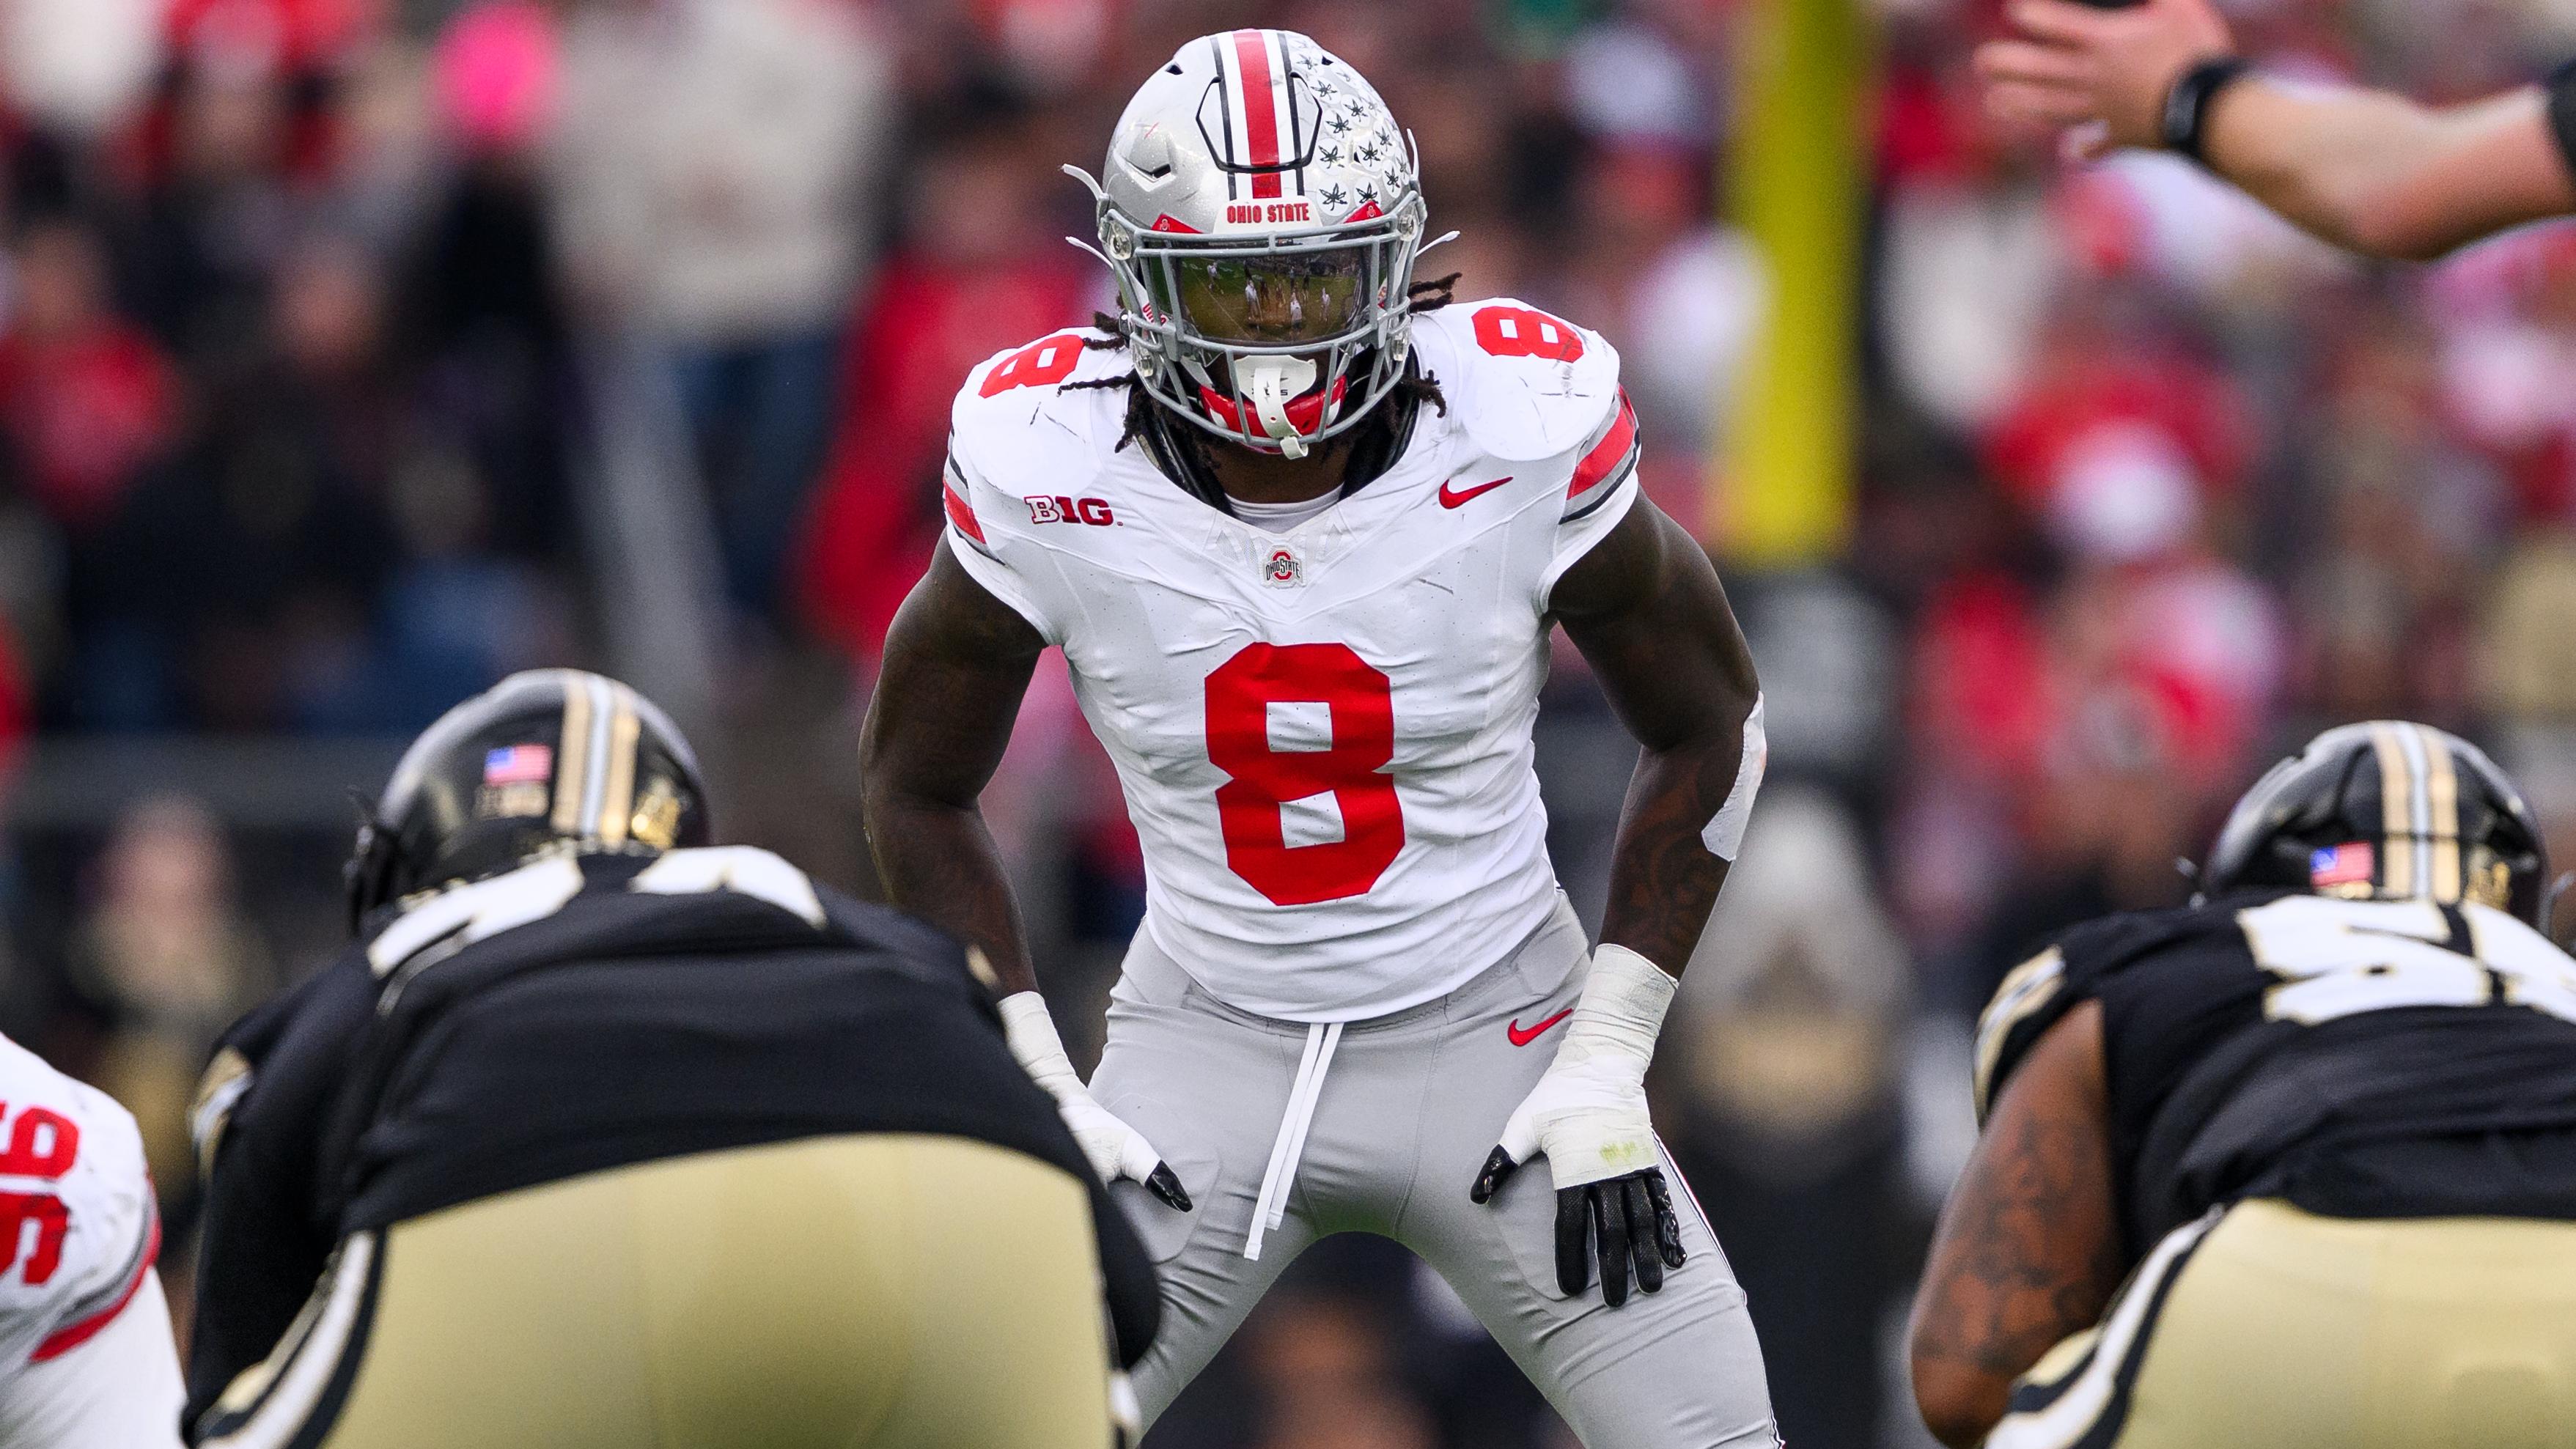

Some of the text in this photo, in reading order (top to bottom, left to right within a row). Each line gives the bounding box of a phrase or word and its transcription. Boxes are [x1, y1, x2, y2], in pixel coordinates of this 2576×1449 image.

[1227, 203, 1309, 223] OHIO STATE
[1471, 306, 1583, 364] 8
[978, 334, 1086, 399] 8
[1204, 641, 1405, 906] 8
